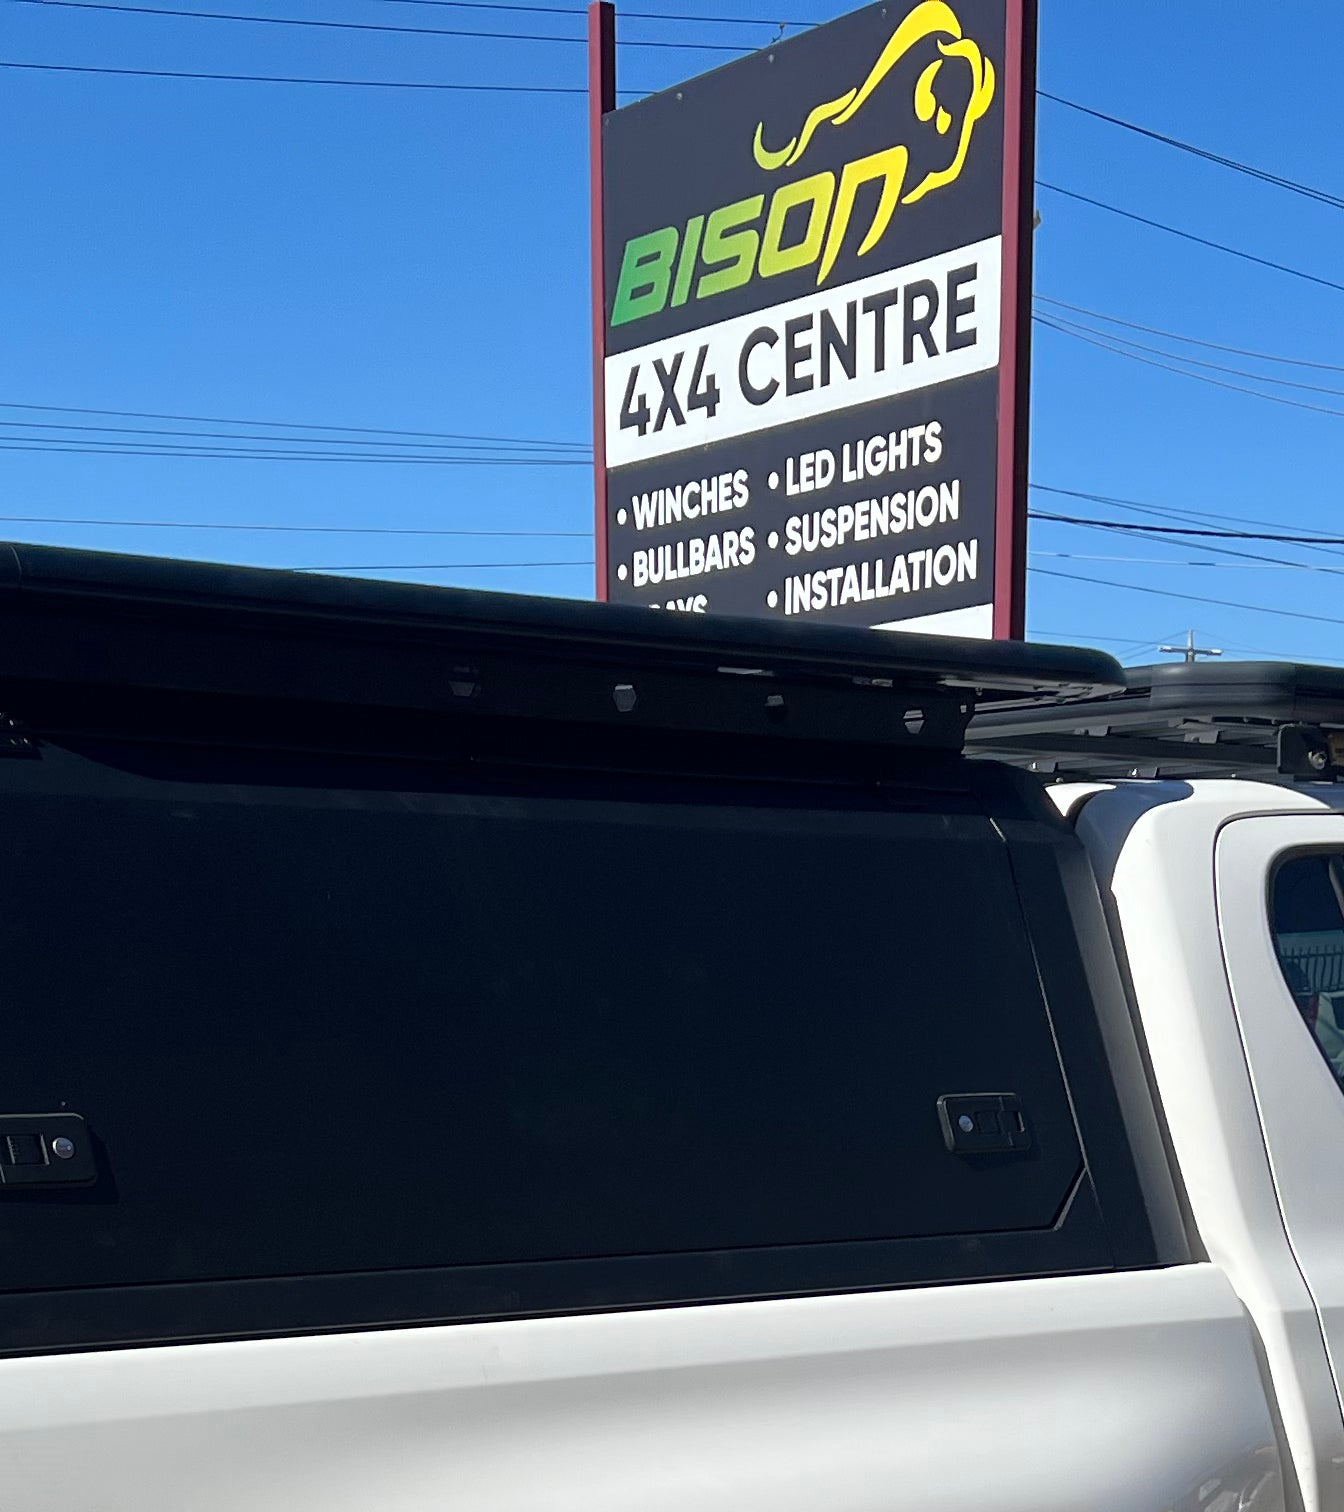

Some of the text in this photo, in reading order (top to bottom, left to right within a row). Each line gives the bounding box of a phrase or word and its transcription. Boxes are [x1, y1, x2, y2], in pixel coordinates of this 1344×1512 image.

[618, 263, 980, 437] 4X4 CENTRE
[785, 420, 944, 497] LED LIGHTS
[632, 469, 749, 532] WINCHES
[784, 480, 961, 556] SUSPENSION
[632, 526, 756, 588] BULLBARS
[783, 539, 979, 616] INSTALLATION
